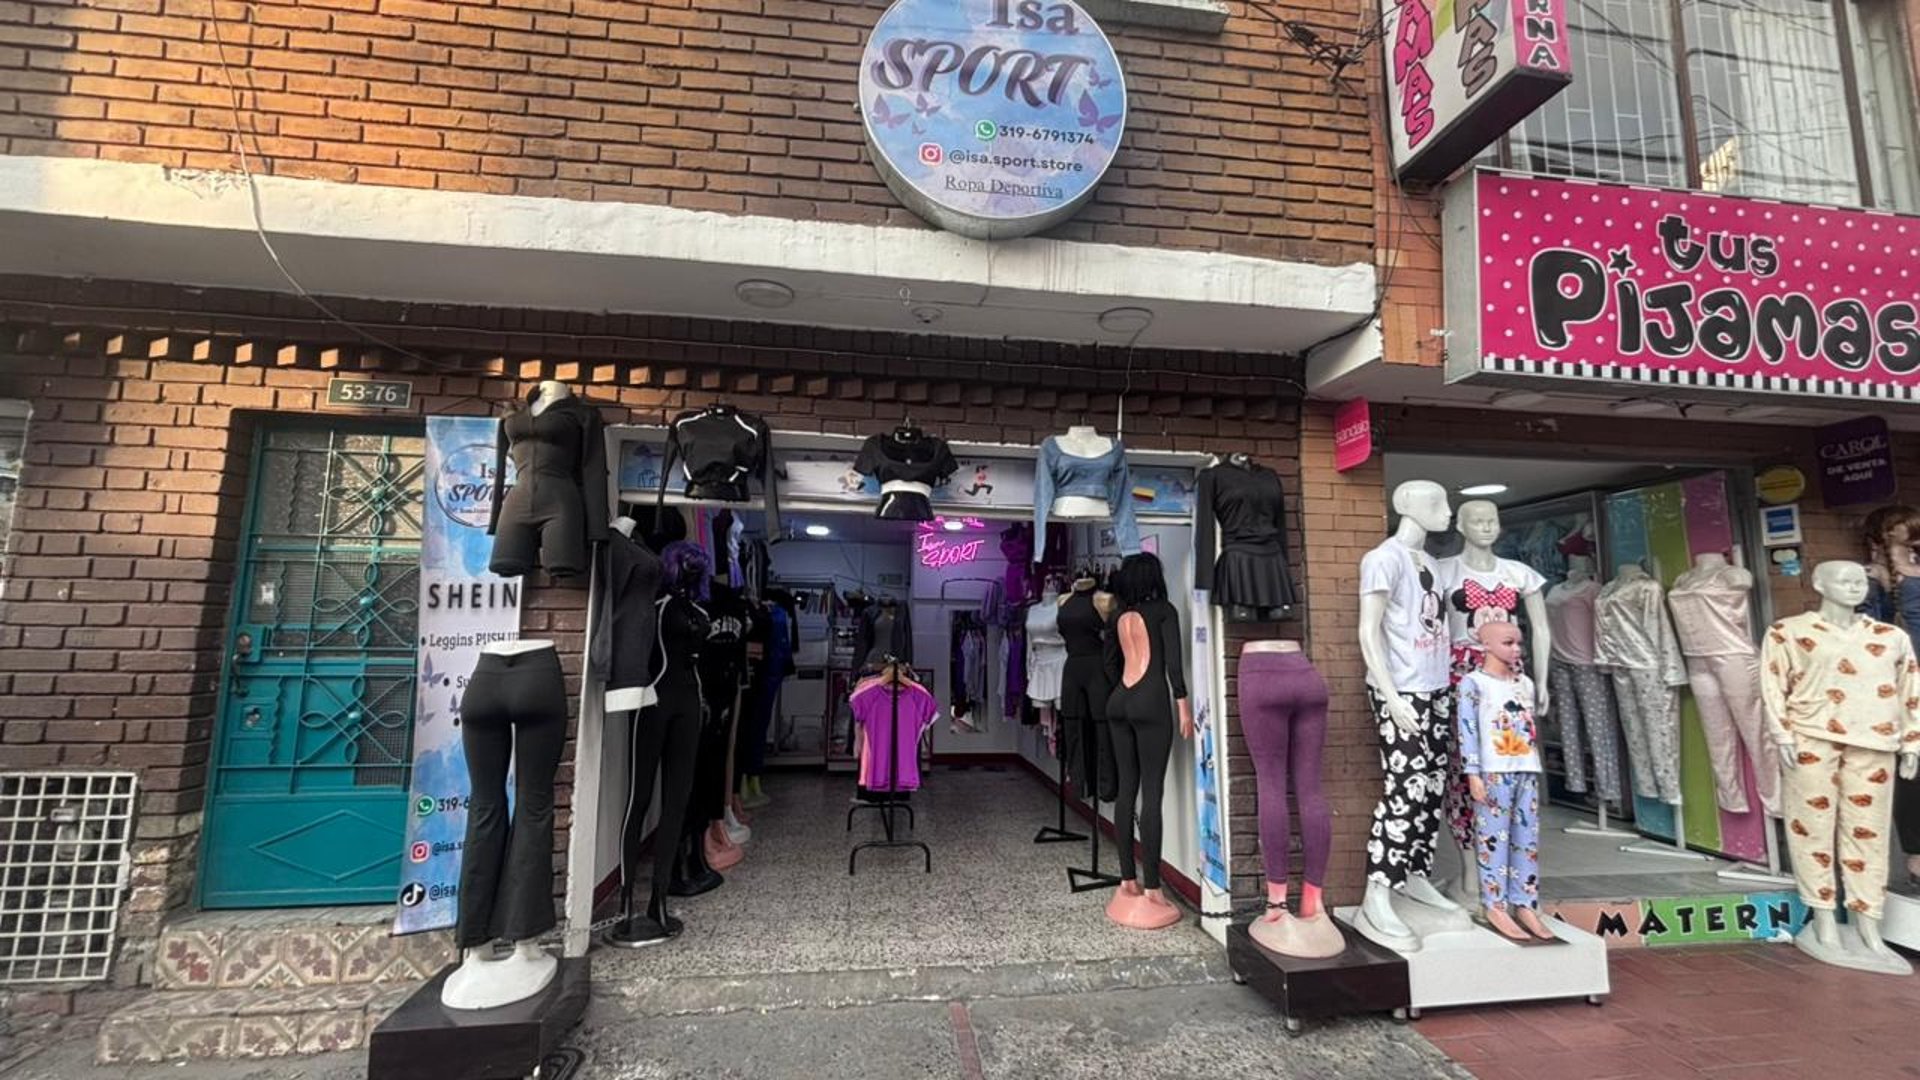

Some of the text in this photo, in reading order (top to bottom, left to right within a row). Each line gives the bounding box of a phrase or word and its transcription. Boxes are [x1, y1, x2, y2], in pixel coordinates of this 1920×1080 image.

[870, 38, 1093, 109] SPORT
[999, 124, 1095, 145] 319-6791374
[949, 149, 1083, 172] @isa.sport.store
[945, 175, 1064, 199] Ropa Deportiva
[1657, 215, 1779, 277] tus
[340, 383, 397, 402] 53-76
[1820, 435, 1887, 458] CAROL
[1827, 459, 1887, 475] DE VENTA
[922, 539, 984, 567] SPORT
[427, 583, 518, 609] SHEIN
[429, 632, 473, 650] Leggins
